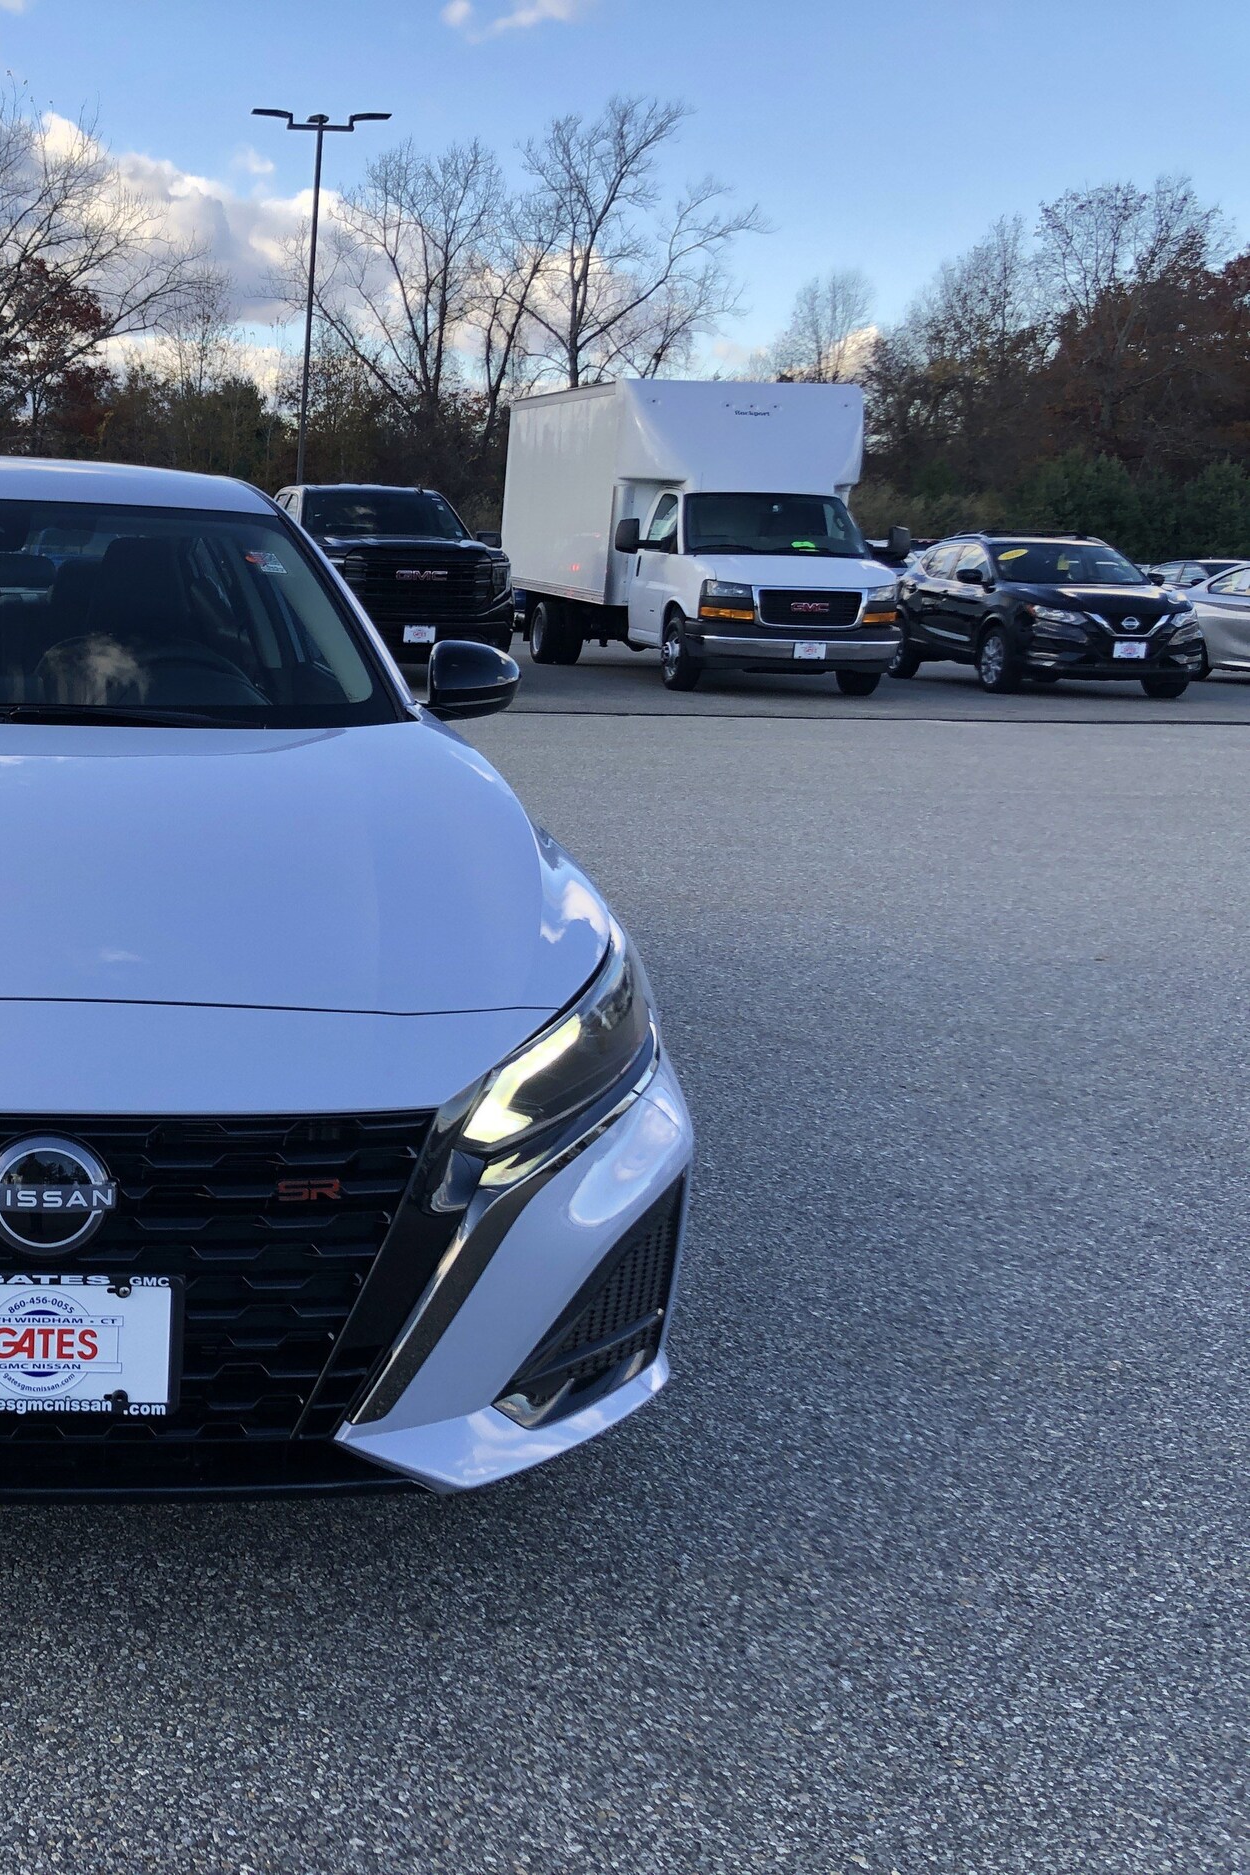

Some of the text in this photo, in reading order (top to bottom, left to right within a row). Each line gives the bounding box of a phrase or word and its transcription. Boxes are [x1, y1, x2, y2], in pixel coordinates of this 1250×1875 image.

[396, 570, 448, 581] GMC
[791, 602, 830, 613] GMC
[278, 1179, 341, 1201] SR
[129, 1276, 170, 1287] GMC
[8, 1296, 75, 1314] 860-456-0055
[3, 1372, 76, 1392] gatesgmcnissan.com
